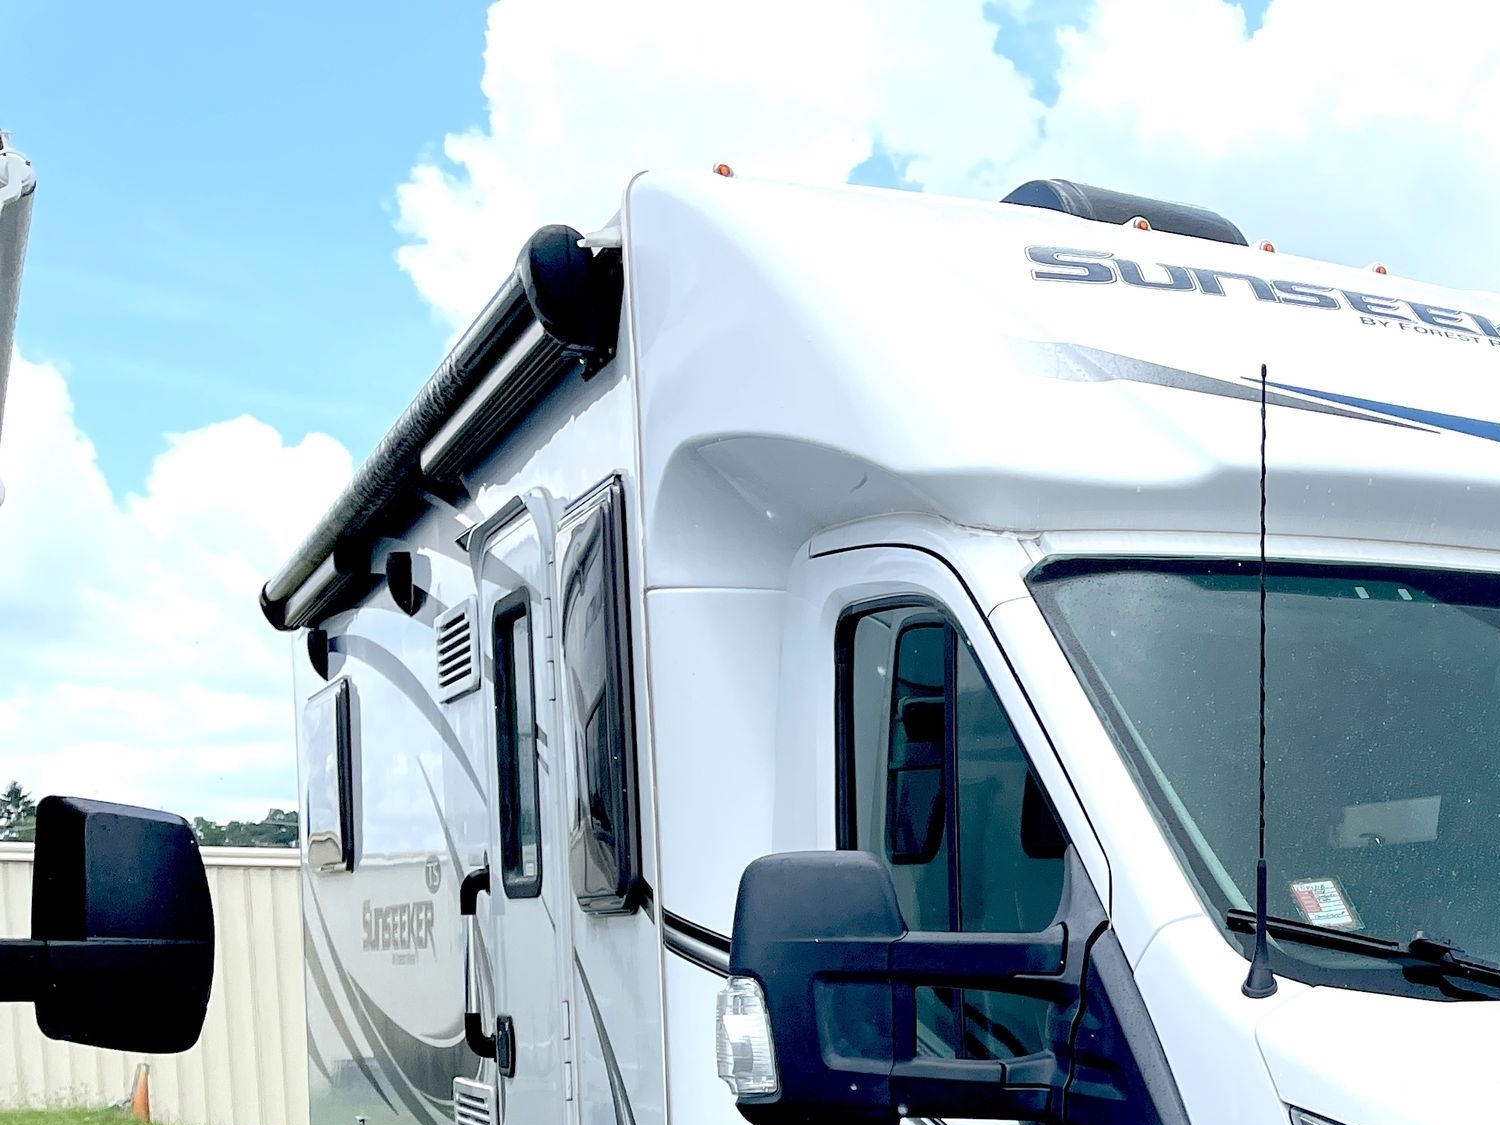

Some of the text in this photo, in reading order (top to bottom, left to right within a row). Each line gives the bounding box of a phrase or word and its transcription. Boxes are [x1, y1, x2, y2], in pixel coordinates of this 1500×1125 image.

[1359, 316, 1389, 328] BY
[1399, 322, 1482, 344] FOREST
[362, 899, 437, 963] SUNSEEKER
